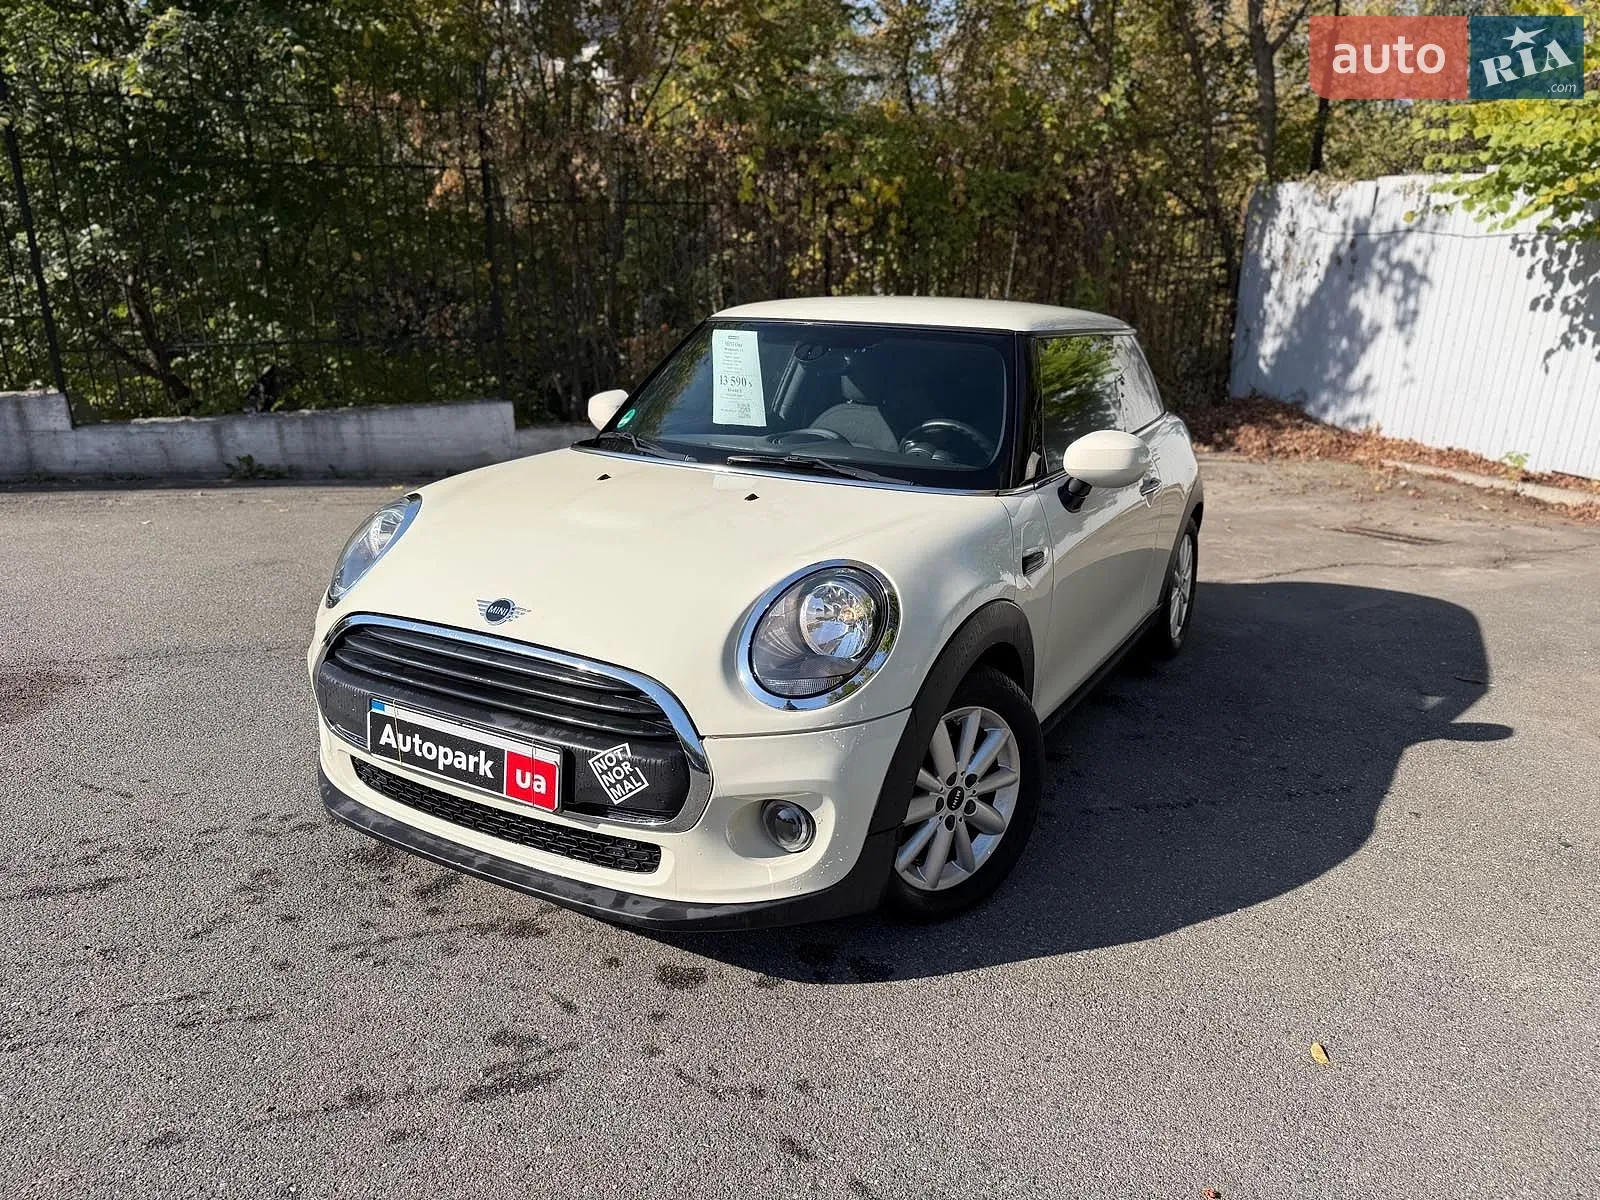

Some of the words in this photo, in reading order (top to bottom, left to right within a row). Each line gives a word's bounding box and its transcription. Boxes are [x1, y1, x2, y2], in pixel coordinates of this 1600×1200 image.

[720, 375, 728, 385] 13
[730, 376, 747, 387] 590
[487, 605, 509, 617] MINI
[379, 723, 495, 779] Autopark
[515, 768, 547, 795] ua
[593, 747, 624, 774] NOT
[601, 761, 634, 787] NOR
[609, 775, 642, 800] MAL
[951, 790, 961, 809] MINI
